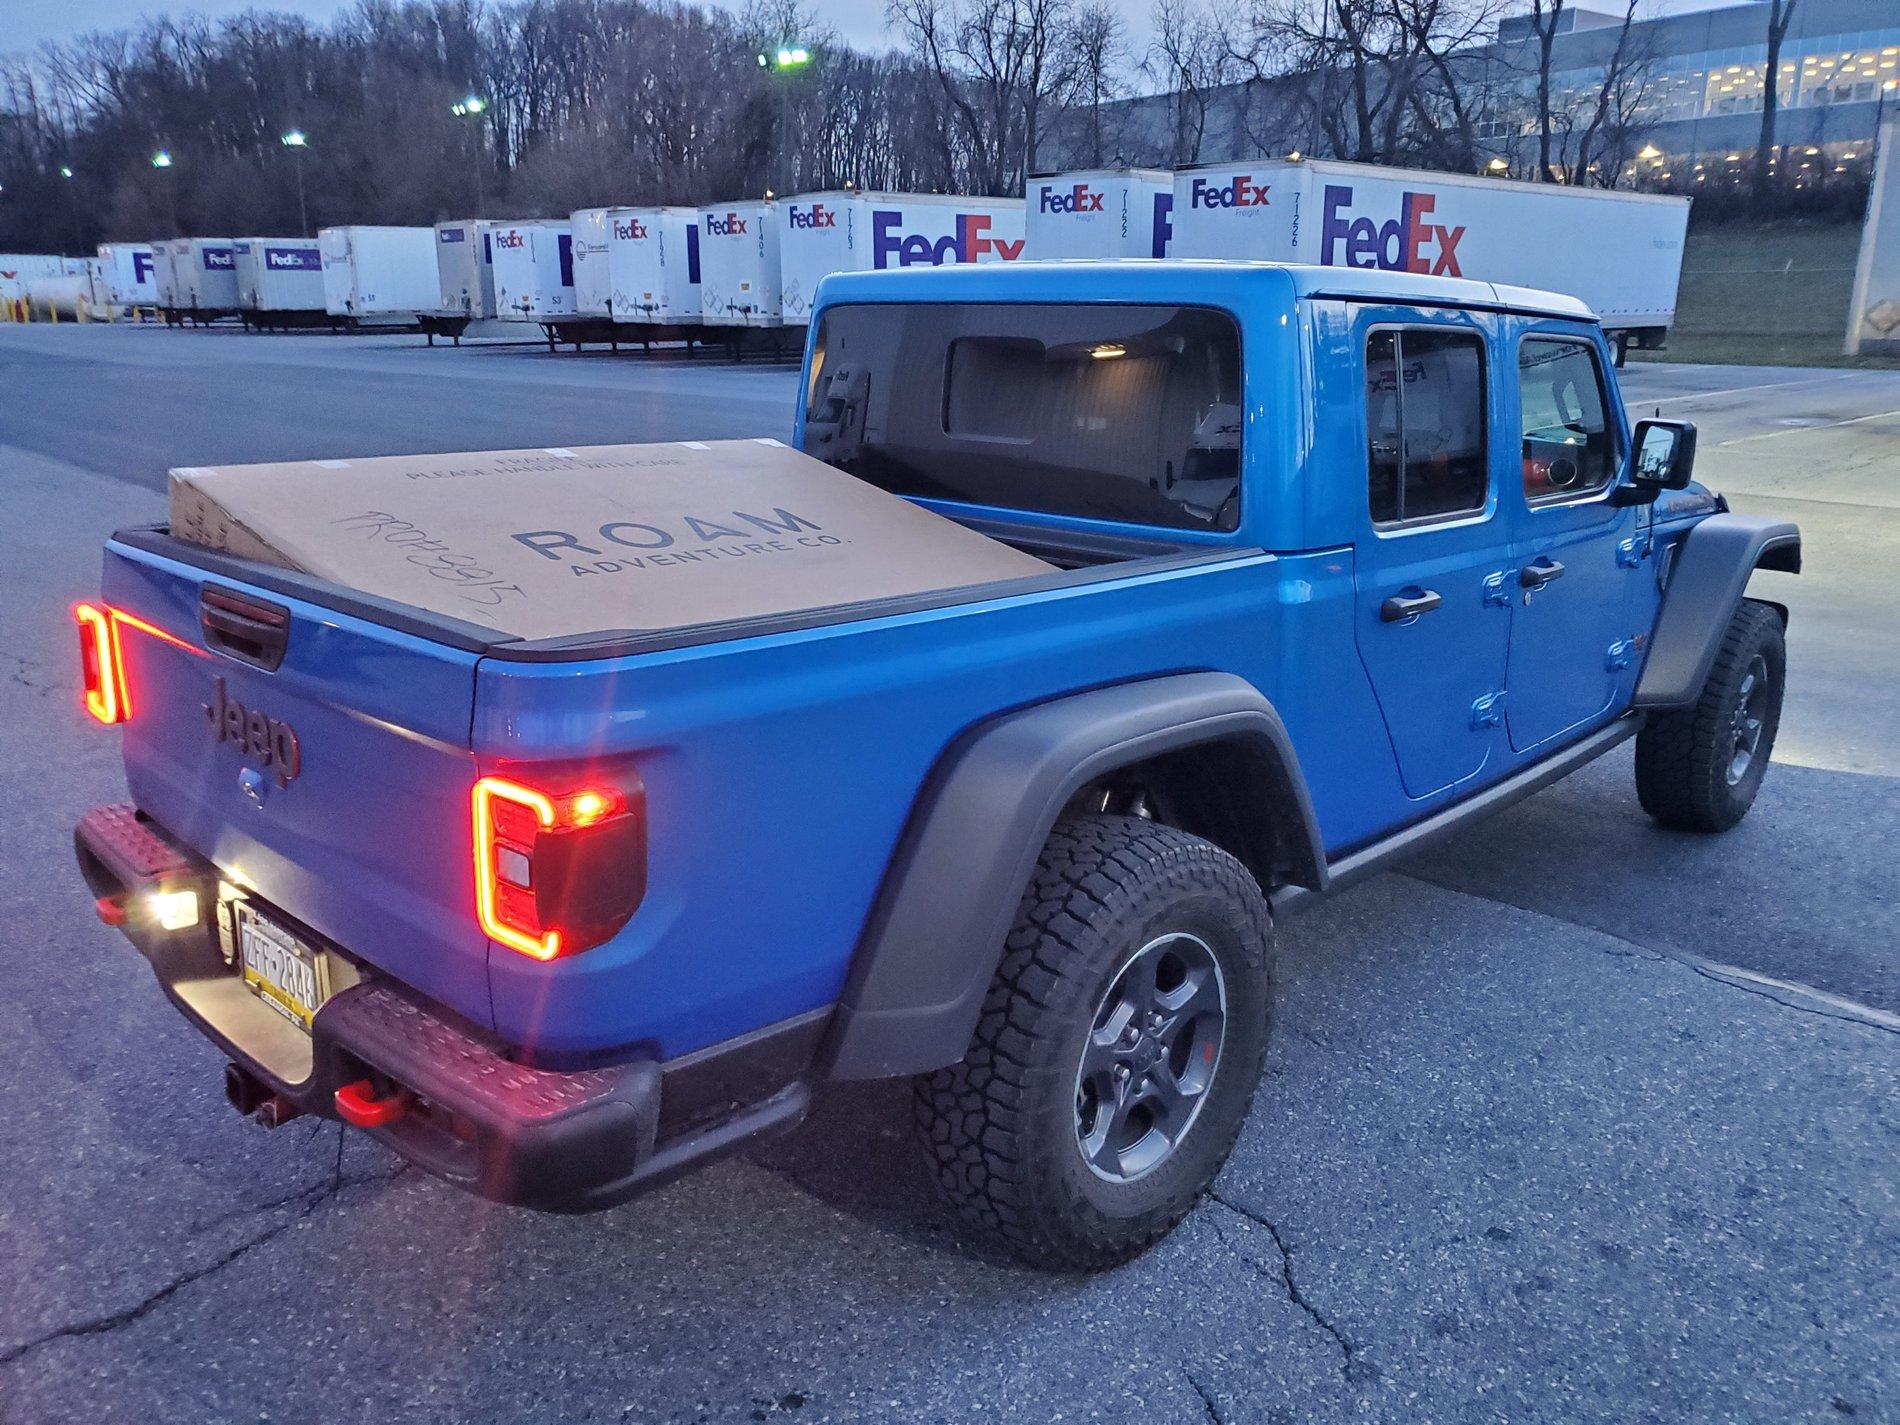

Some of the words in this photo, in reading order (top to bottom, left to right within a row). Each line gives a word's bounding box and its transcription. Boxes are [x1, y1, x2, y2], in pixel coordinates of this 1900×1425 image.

[1040, 184, 1105, 214] FedEx
[1191, 176, 1272, 209] FedEx
[706, 213, 748, 235] FedEx
[789, 204, 836, 229] FedEx
[1235, 209, 1260, 218] Freight
[1291, 192, 1301, 247] 71226
[496, 230, 525, 249] FedEx
[613, 219, 648, 240] FedEx
[1320, 184, 1467, 278] FedEx
[510, 507, 823, 561] ROAM
[570, 539, 794, 578] ADVENTURE
[796, 534, 854, 549] CO.
[200, 676, 301, 792] Jeep
